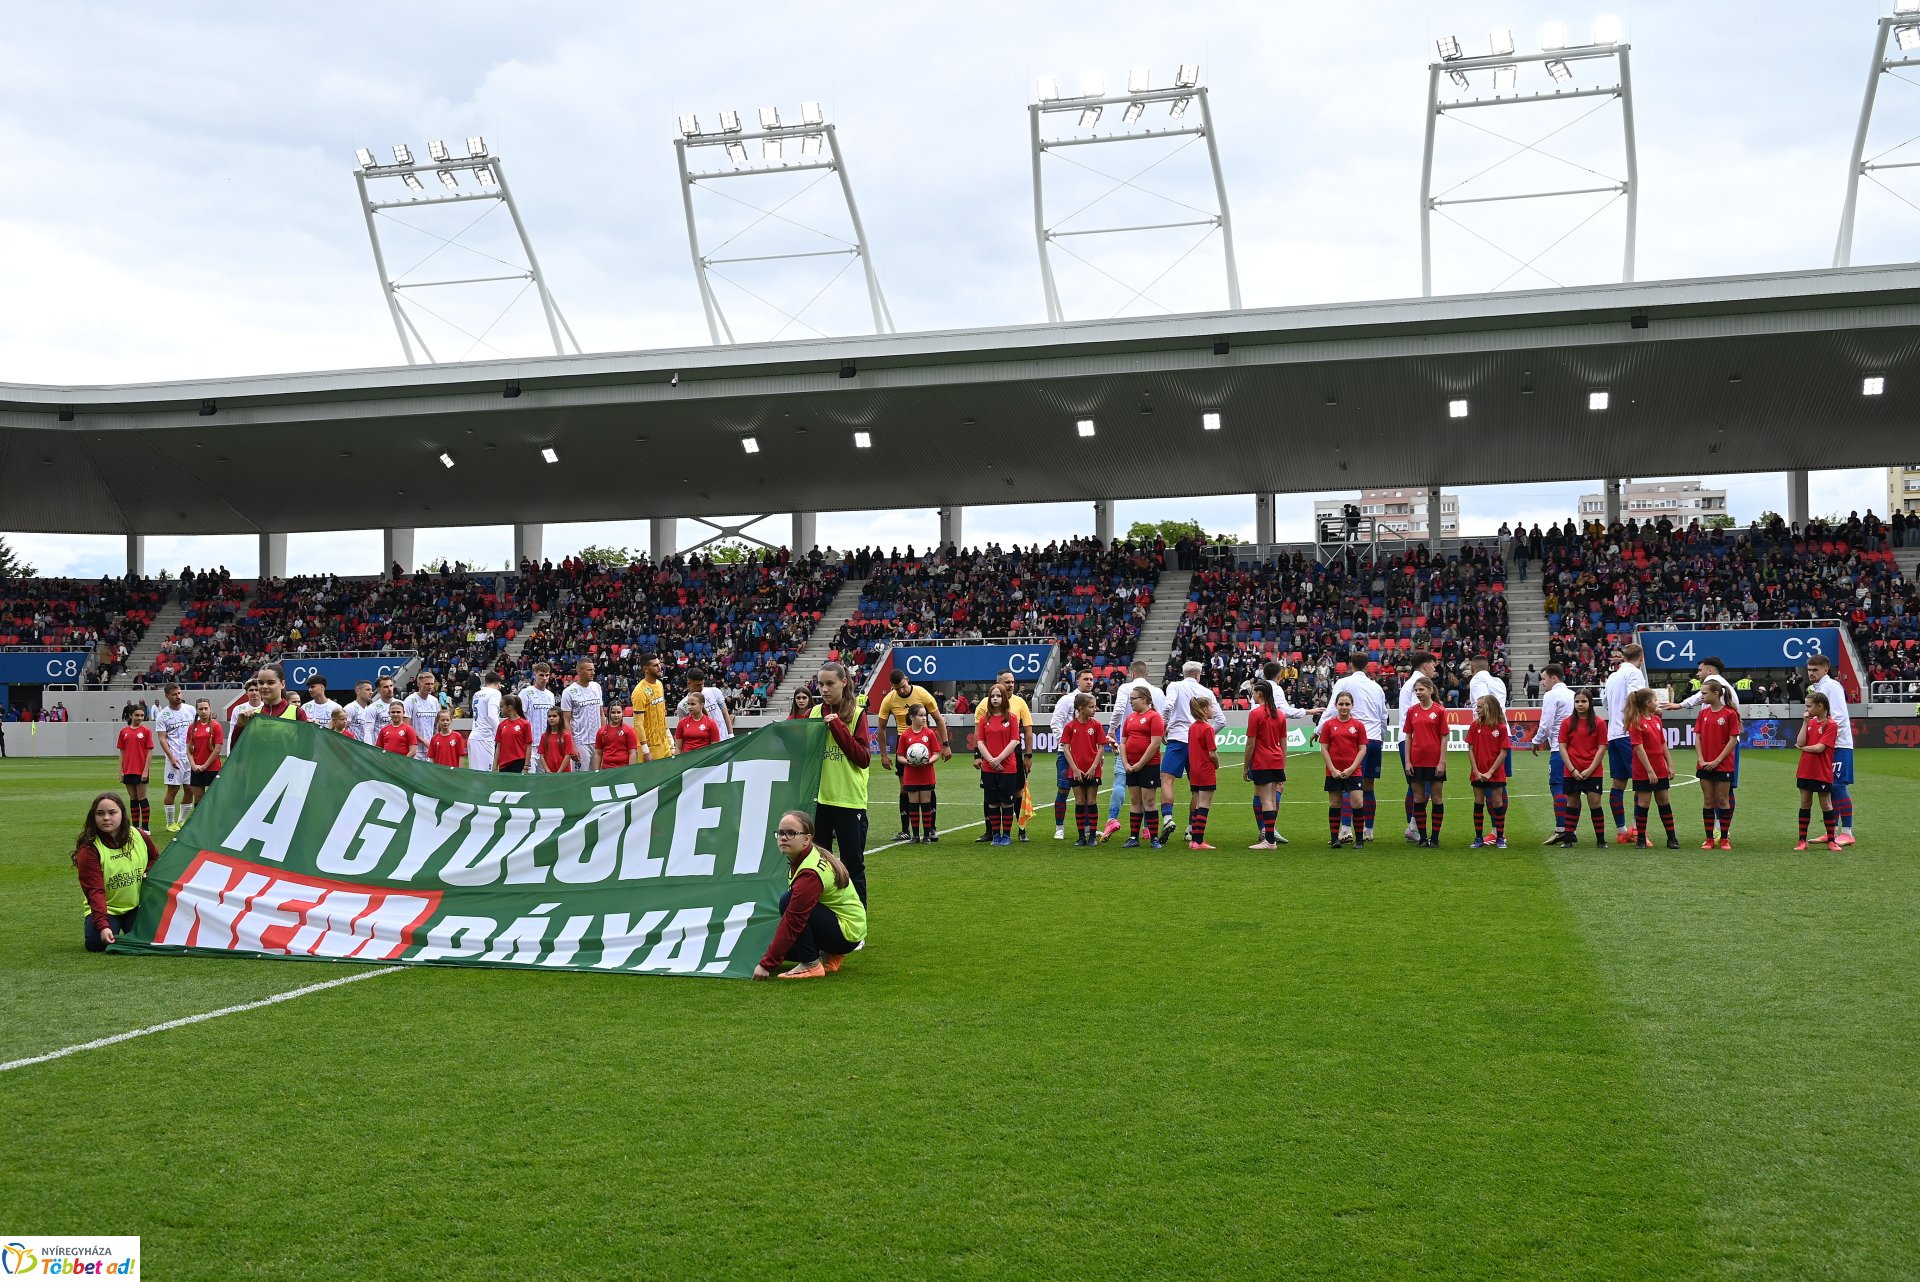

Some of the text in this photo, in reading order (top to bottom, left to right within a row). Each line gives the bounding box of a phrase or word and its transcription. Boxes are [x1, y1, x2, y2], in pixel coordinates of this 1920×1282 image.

[1655, 639, 1697, 662] C4
[1782, 637, 1822, 660] C3
[46, 659, 78, 677] C8
[906, 655, 937, 675] C6
[1008, 653, 1041, 673] C5
[292, 666, 318, 685] C8
[221, 754, 791, 887] A GYŰLÖLET
[155, 860, 756, 974] NEM PÁLYA!
